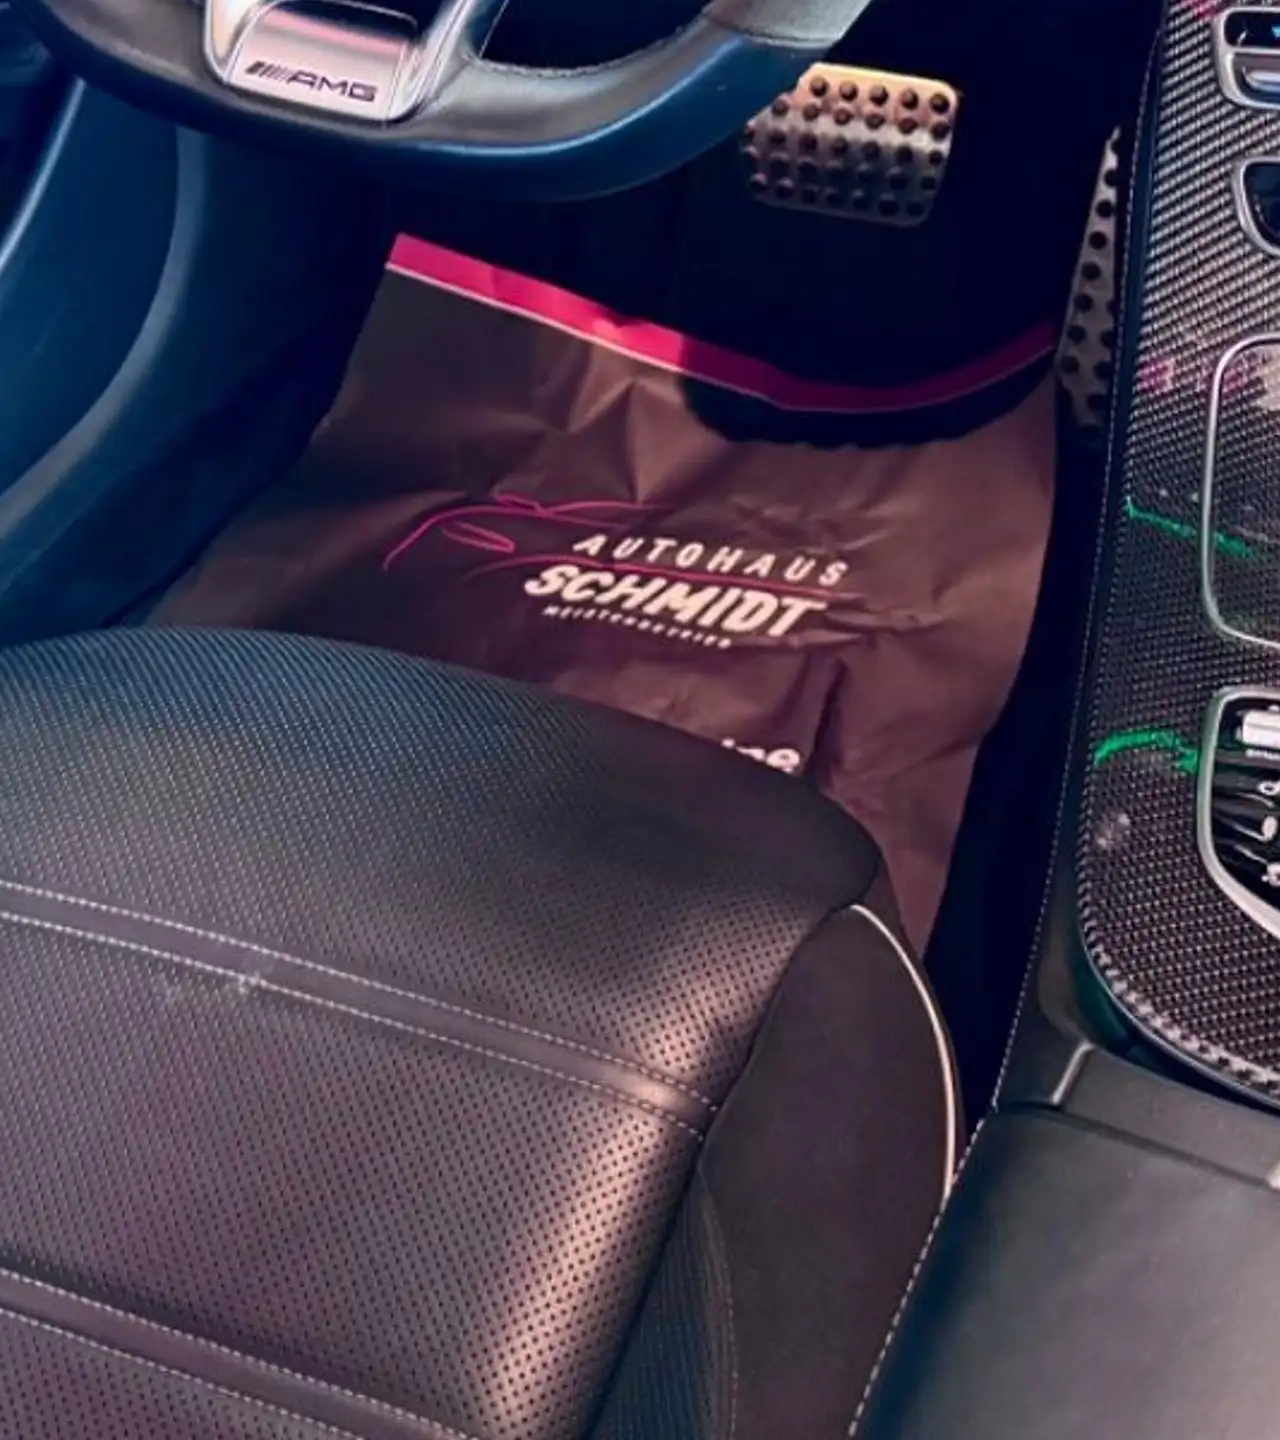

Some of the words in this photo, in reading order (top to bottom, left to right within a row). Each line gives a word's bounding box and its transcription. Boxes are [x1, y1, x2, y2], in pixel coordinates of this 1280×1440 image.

[287, 69, 378, 103] AMG
[573, 533, 849, 586] AUTOHAUS
[524, 564, 829, 637] SCHMIDT
